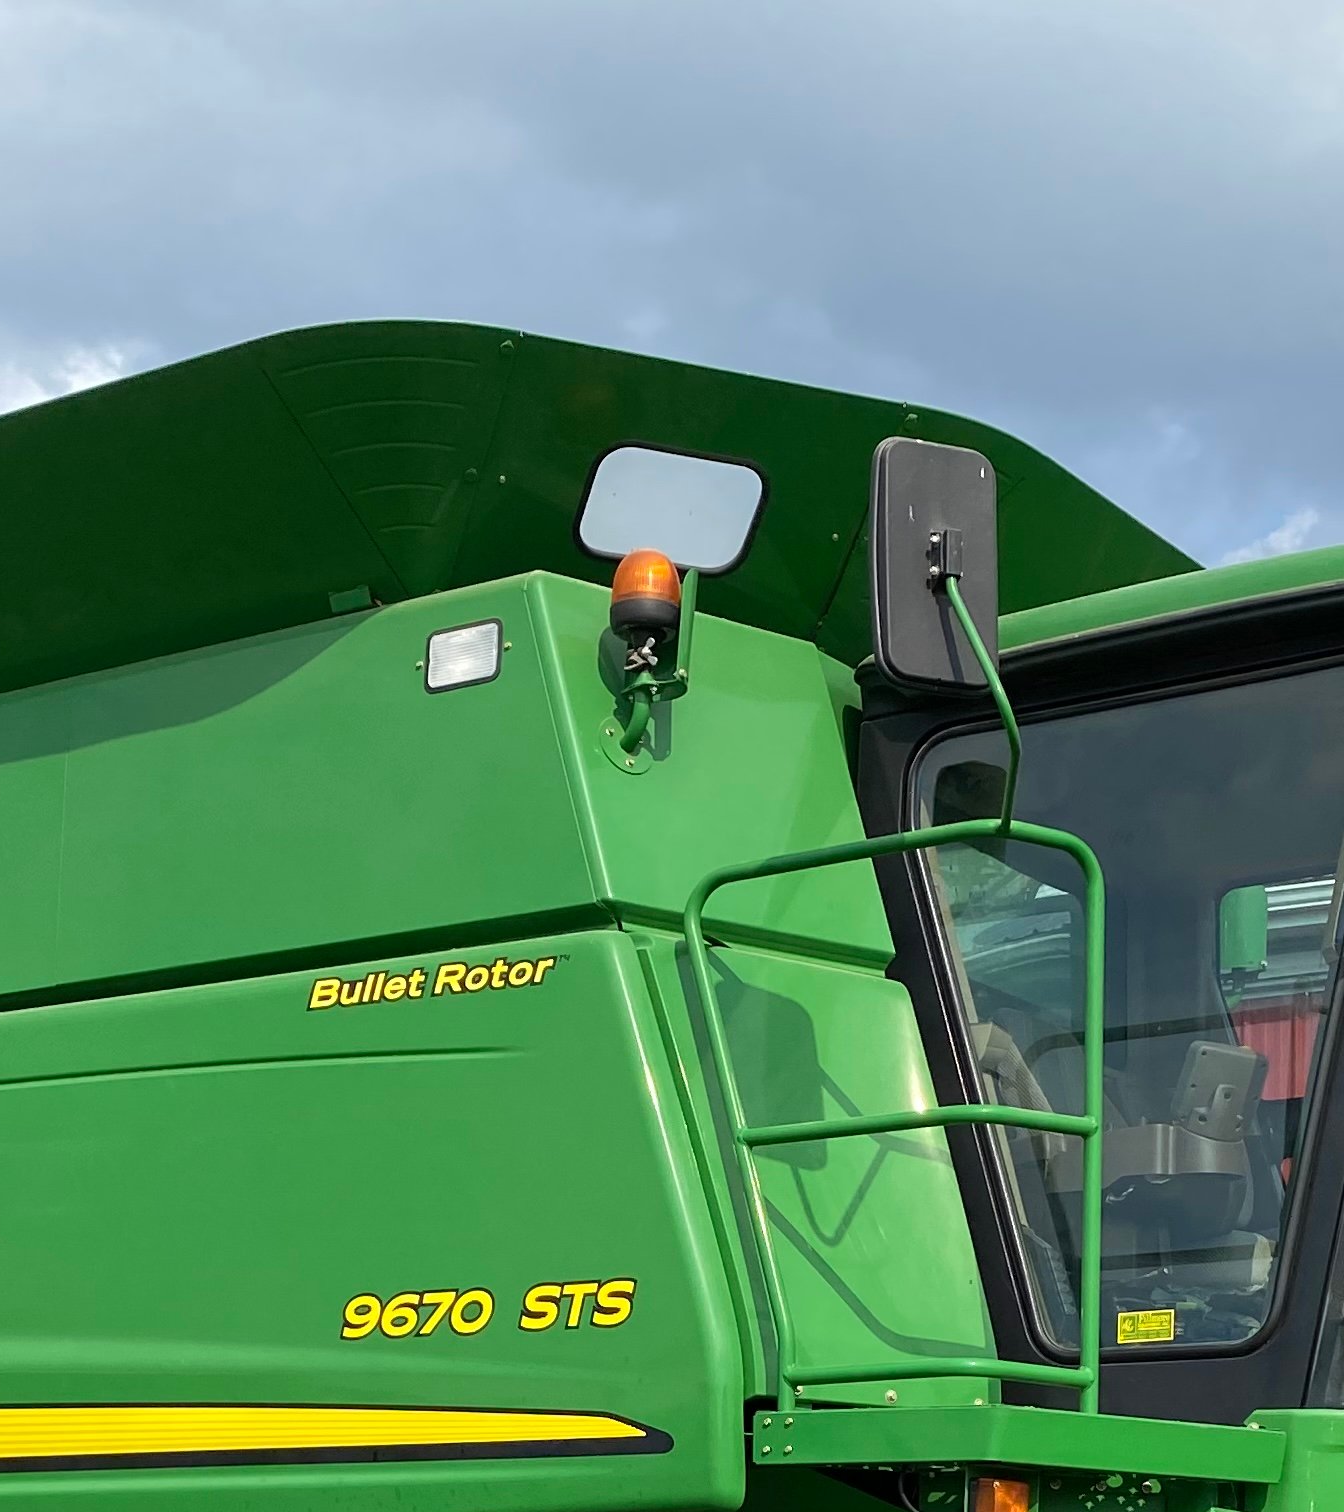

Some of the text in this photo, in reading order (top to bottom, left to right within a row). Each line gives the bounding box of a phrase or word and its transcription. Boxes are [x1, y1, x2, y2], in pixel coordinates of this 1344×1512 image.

[307, 967, 427, 1011] Bullet
[431, 955, 557, 997] Rotor
[340, 1277, 637, 1341] 9670 STS
